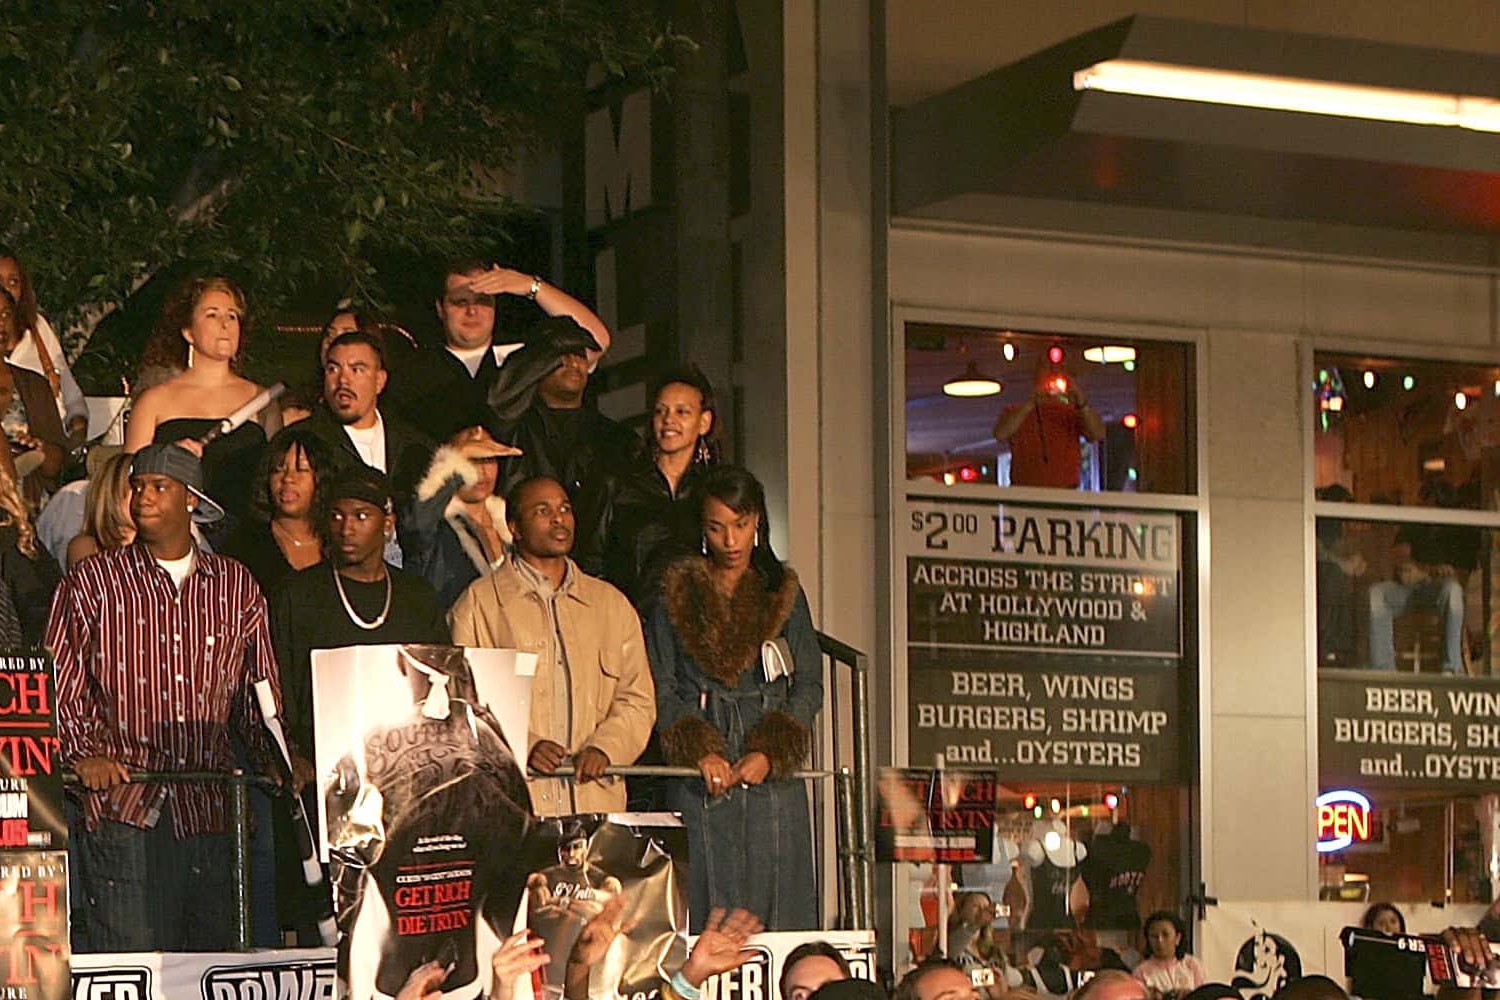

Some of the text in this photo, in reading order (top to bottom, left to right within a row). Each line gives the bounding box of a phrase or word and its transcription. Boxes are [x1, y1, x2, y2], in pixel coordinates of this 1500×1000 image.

[991, 515, 1172, 561] PARKING
[914, 565, 1172, 596] ACCROSS THE STREET
[940, 593, 1147, 621] AT HOLLYWOOD &
[984, 621, 1105, 645] HIGHLAND
[30, 657, 45, 670] BY
[952, 672, 1134, 700] BEER, WINGS
[1366, 688, 1438, 718] BEER,
[918, 704, 1168, 736] BURGERS, SHRIMP
[1335, 718, 1457, 750] BURGERS,
[1318, 805, 1368, 839] PEN
[38, 865, 55, 878] BY
[396, 880, 471, 907] GET RICH
[398, 916, 427, 935] DIE
